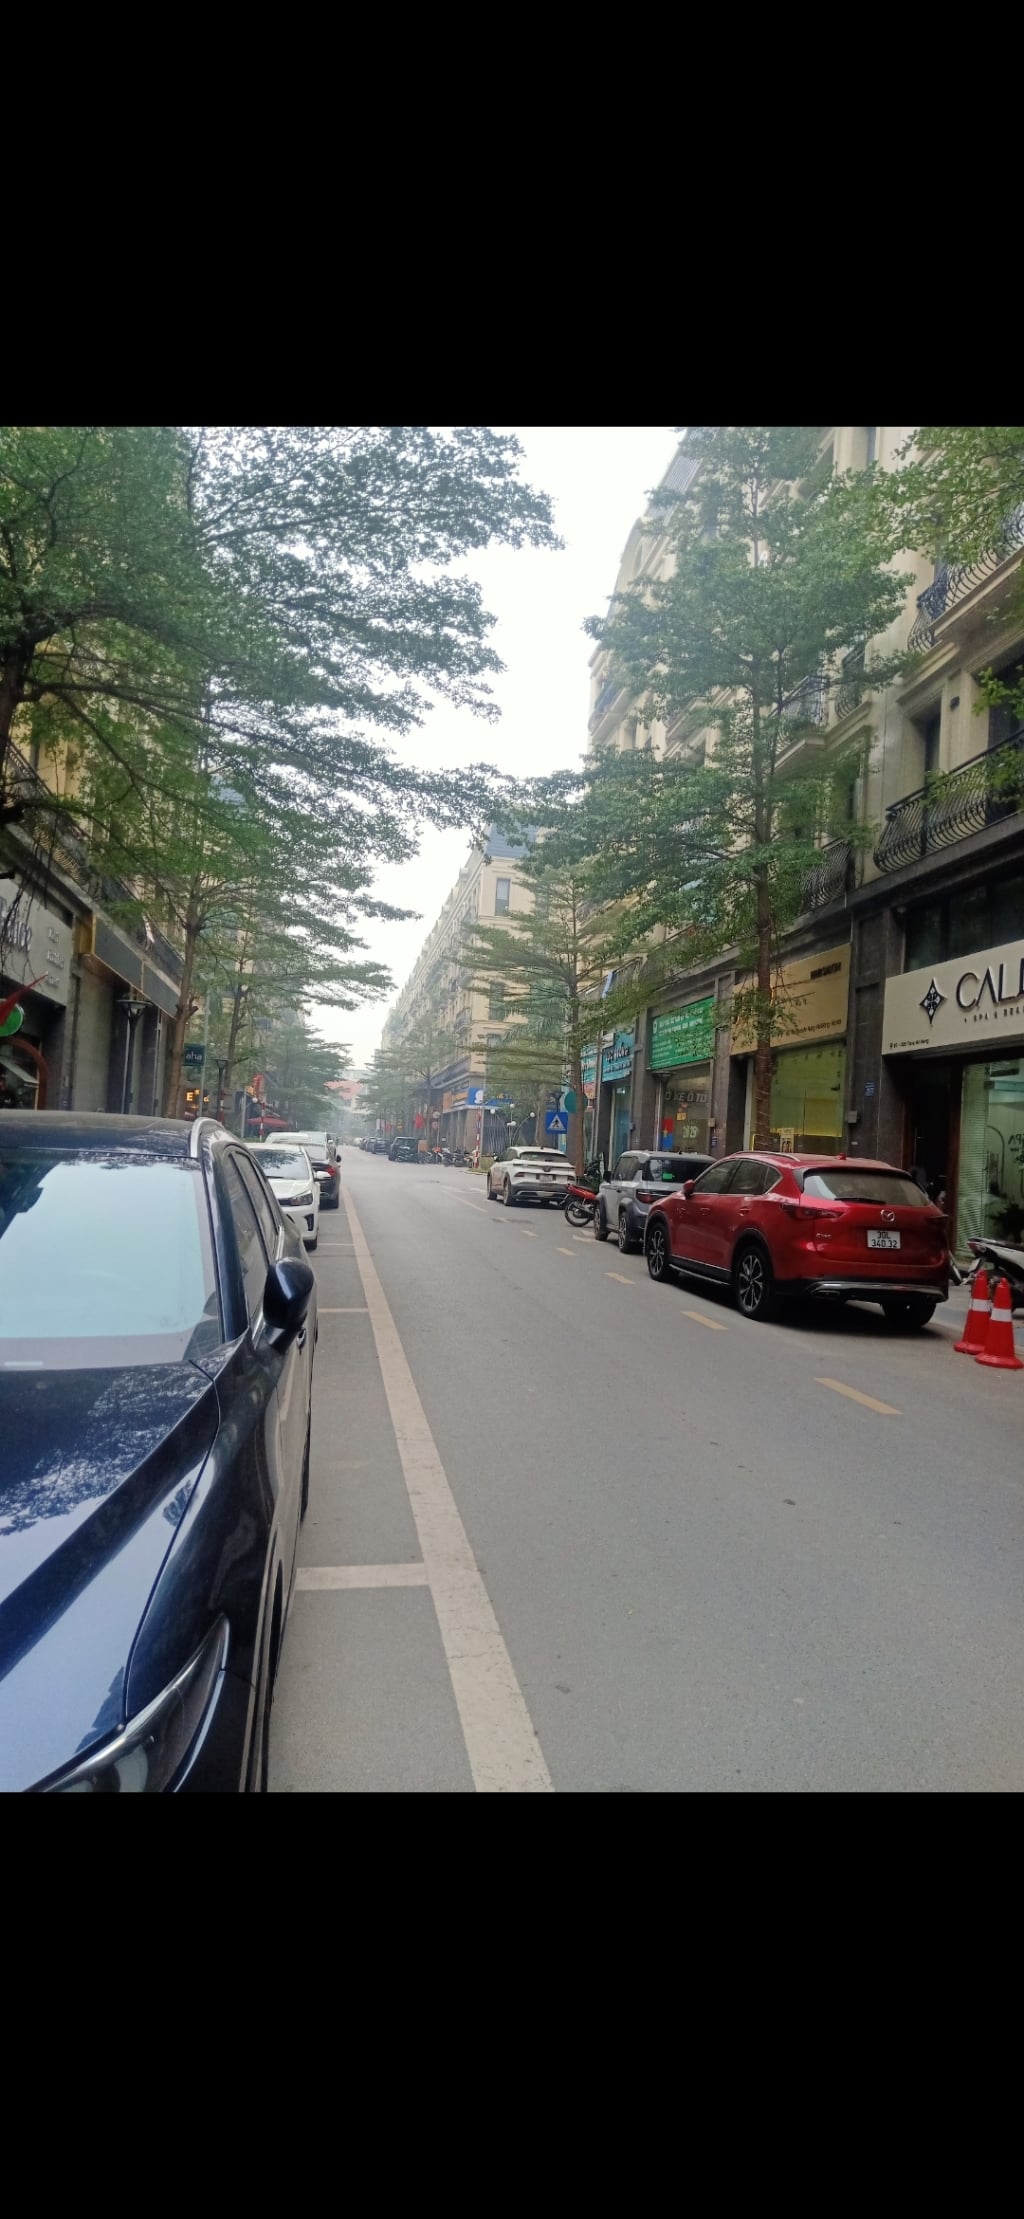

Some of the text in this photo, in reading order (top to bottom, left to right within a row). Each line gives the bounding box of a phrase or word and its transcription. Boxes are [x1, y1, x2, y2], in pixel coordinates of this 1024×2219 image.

[956, 958, 1024, 1009] CAL
[185, 1050, 202, 1061] aha
[877, 1231, 891, 1239] 30L
